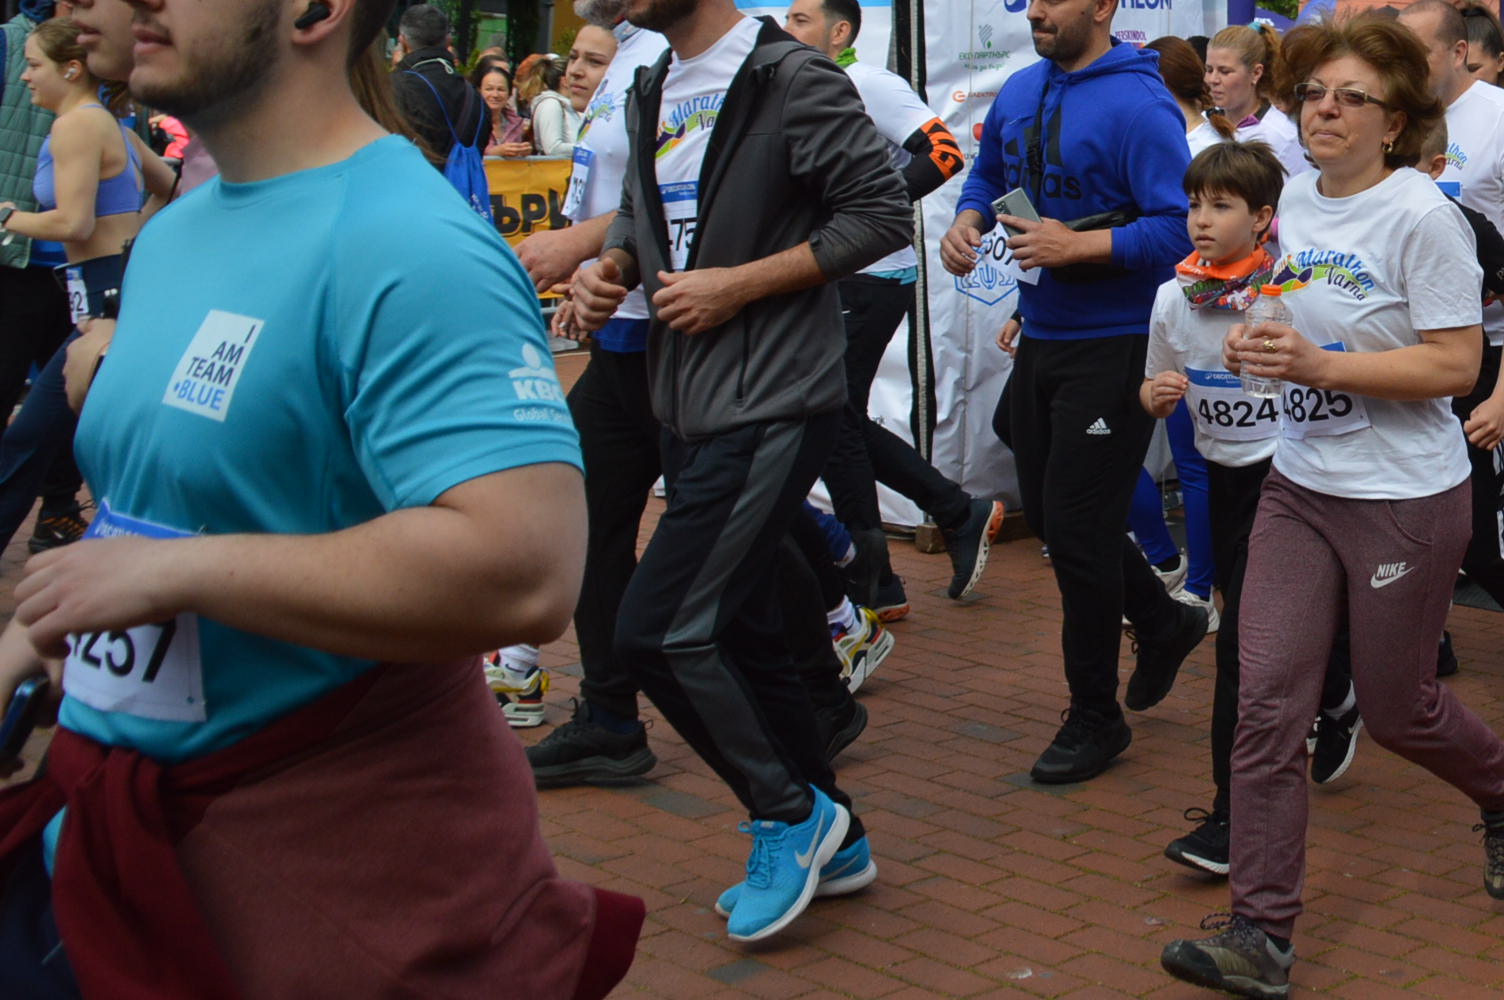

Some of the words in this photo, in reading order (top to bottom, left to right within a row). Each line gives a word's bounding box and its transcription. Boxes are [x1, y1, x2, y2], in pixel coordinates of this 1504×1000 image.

[1447, 142, 1467, 165] thon
[1296, 248, 1375, 292] Marathon
[1324, 266, 1366, 301] Varna
[244, 324, 256, 344] I
[211, 341, 244, 365] AM
[186, 356, 235, 387] TEAM
[1198, 397, 1279, 428] 4824
[1283, 387, 1353, 424] 4825
[1086, 427, 1111, 435] adidas
[1376, 561, 1407, 578] NIKE
